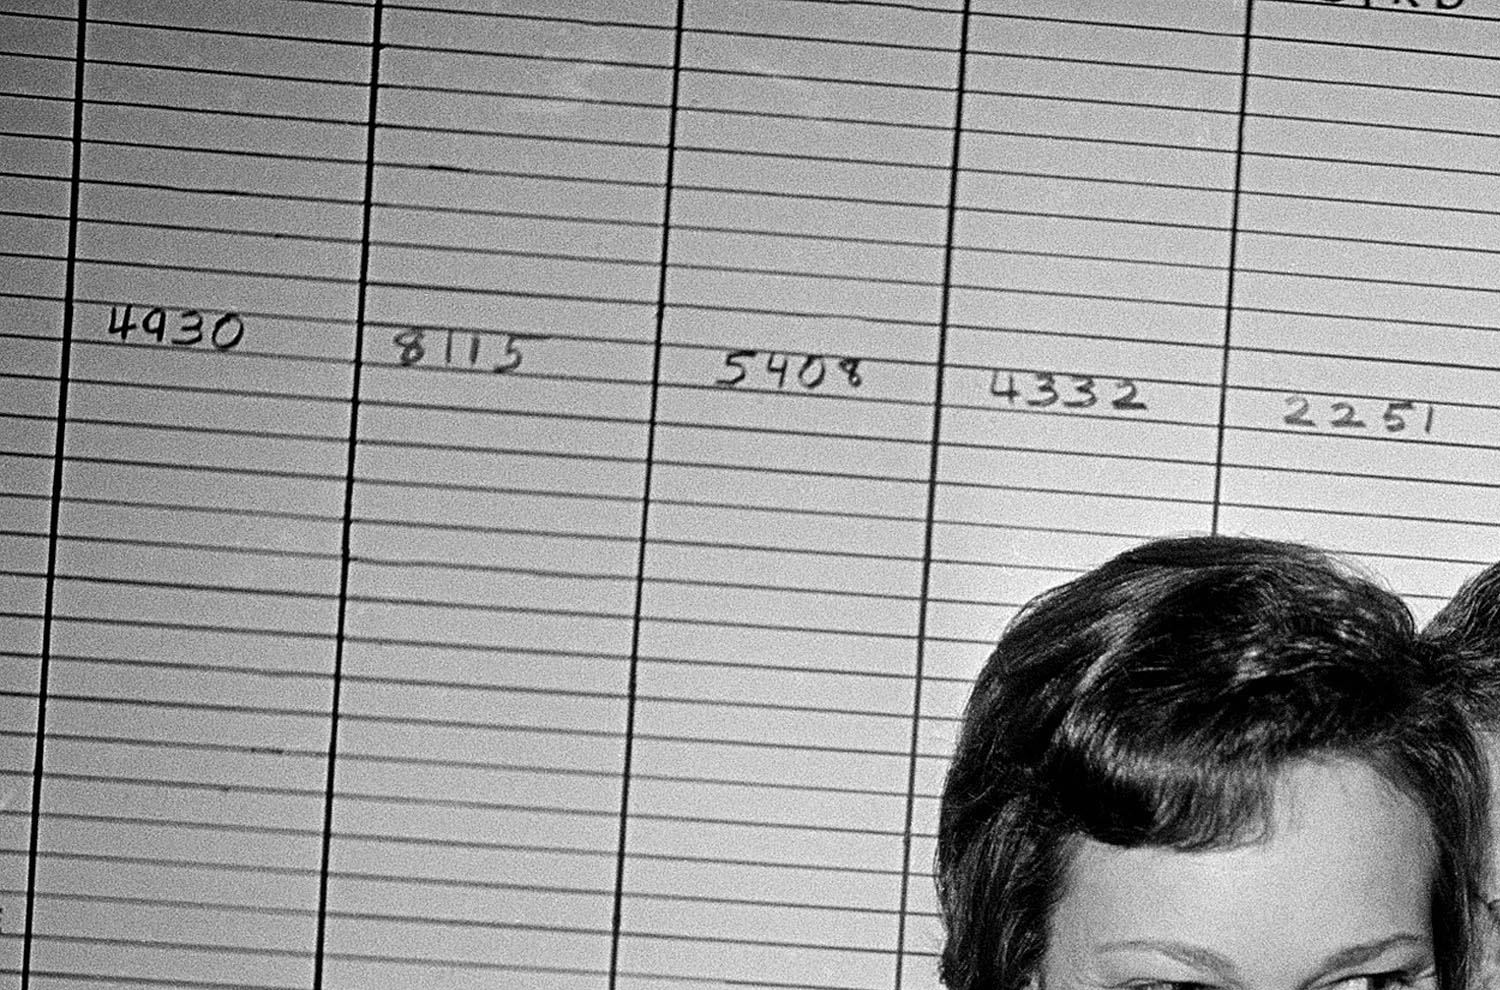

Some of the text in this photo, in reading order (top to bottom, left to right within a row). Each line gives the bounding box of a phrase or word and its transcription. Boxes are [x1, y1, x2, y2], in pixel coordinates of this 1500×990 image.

[108, 304, 246, 351] 4930
[392, 326, 546, 374] 8115
[716, 350, 863, 389] 5408
[989, 371, 1147, 410] 4332
[1283, 396, 1433, 434] 2251
